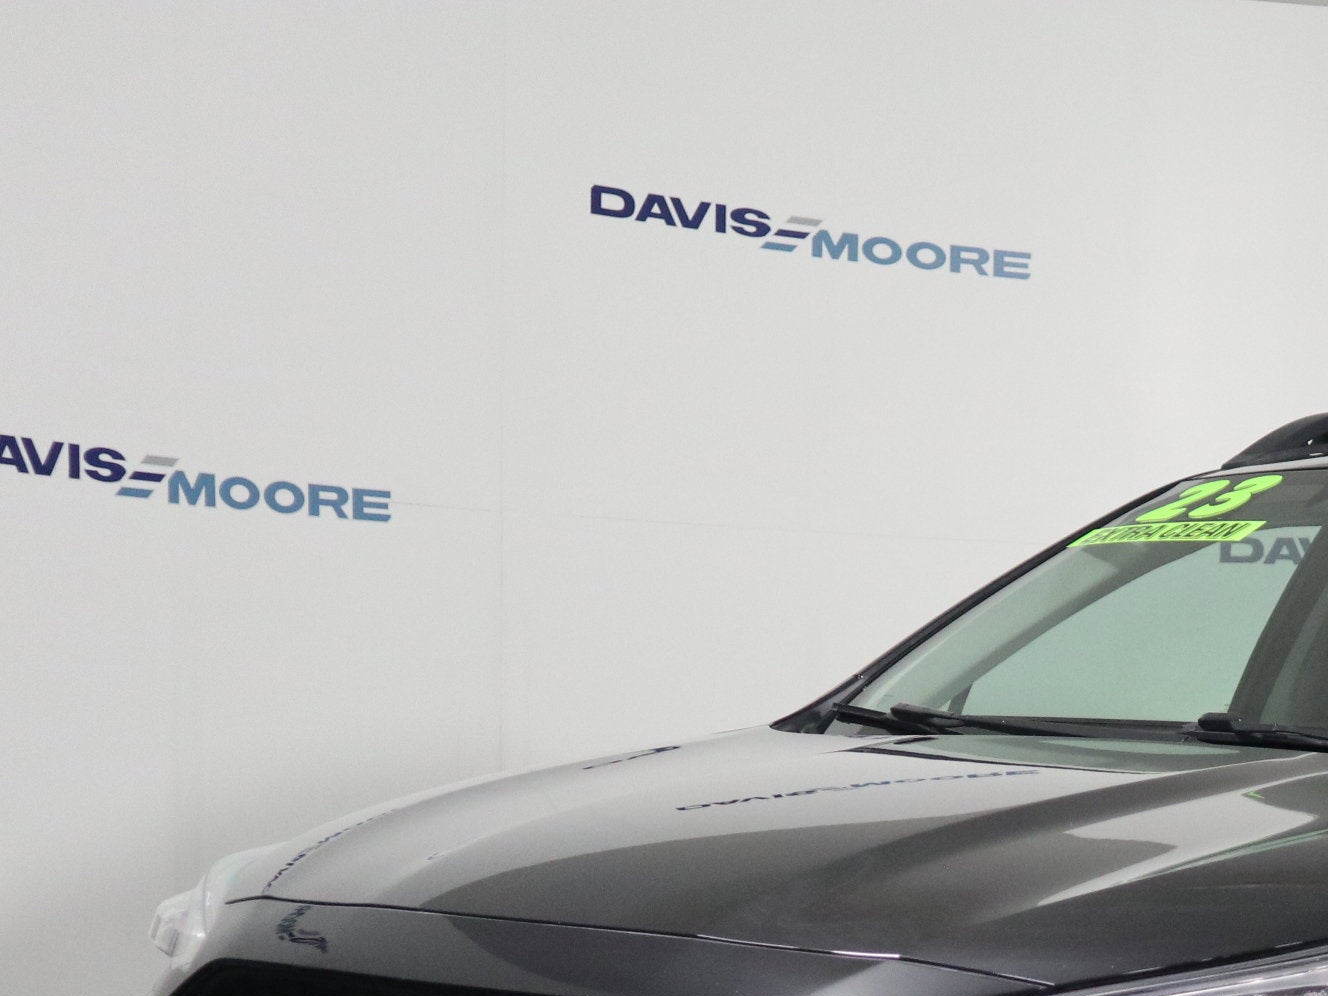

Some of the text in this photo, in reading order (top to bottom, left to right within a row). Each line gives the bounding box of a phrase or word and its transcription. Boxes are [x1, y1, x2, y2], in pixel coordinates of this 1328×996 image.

[590, 184, 1032, 280] DAVIS MOORE
[167, 470, 392, 523] MOORE
[1134, 474, 1284, 523] 23
[1083, 522, 1250, 544] EXTRA CLEAN
